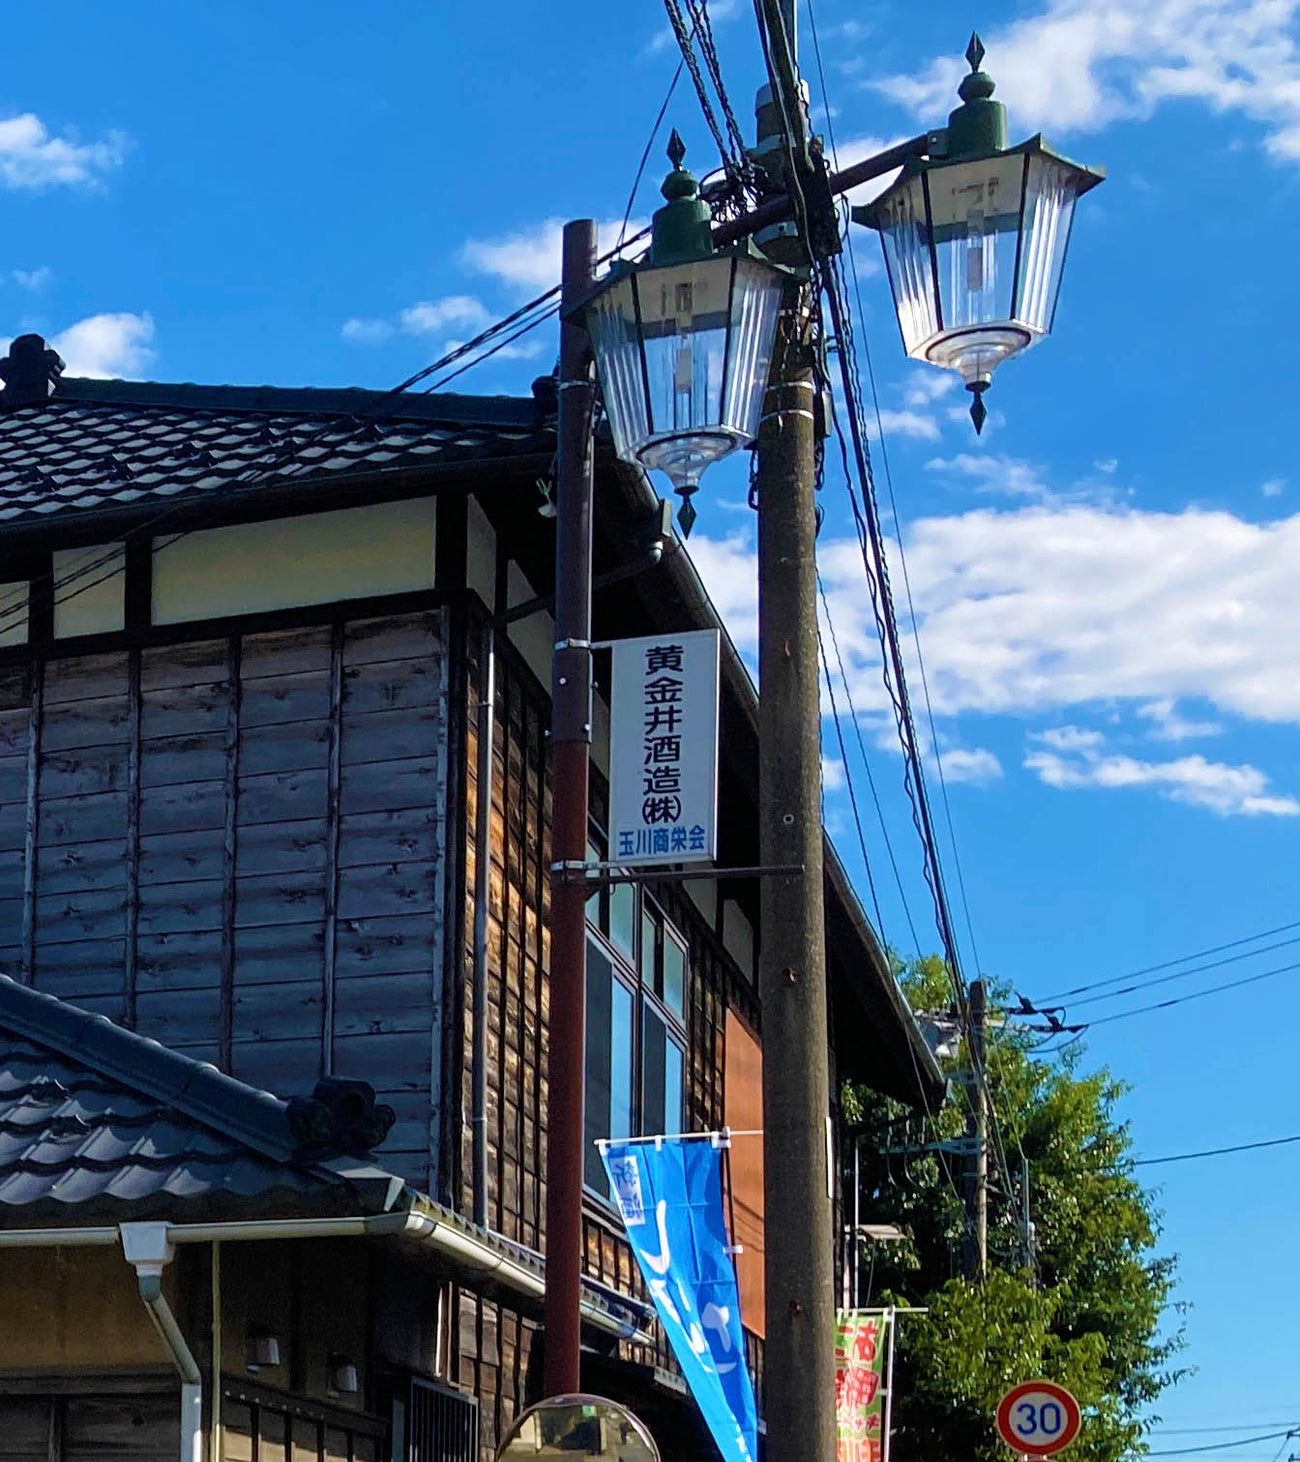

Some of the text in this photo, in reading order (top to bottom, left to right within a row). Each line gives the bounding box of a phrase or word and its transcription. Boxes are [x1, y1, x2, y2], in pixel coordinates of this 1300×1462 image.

[619, 824, 705, 856] 玉川商栄会
[1017, 1403, 1061, 1434] 30
